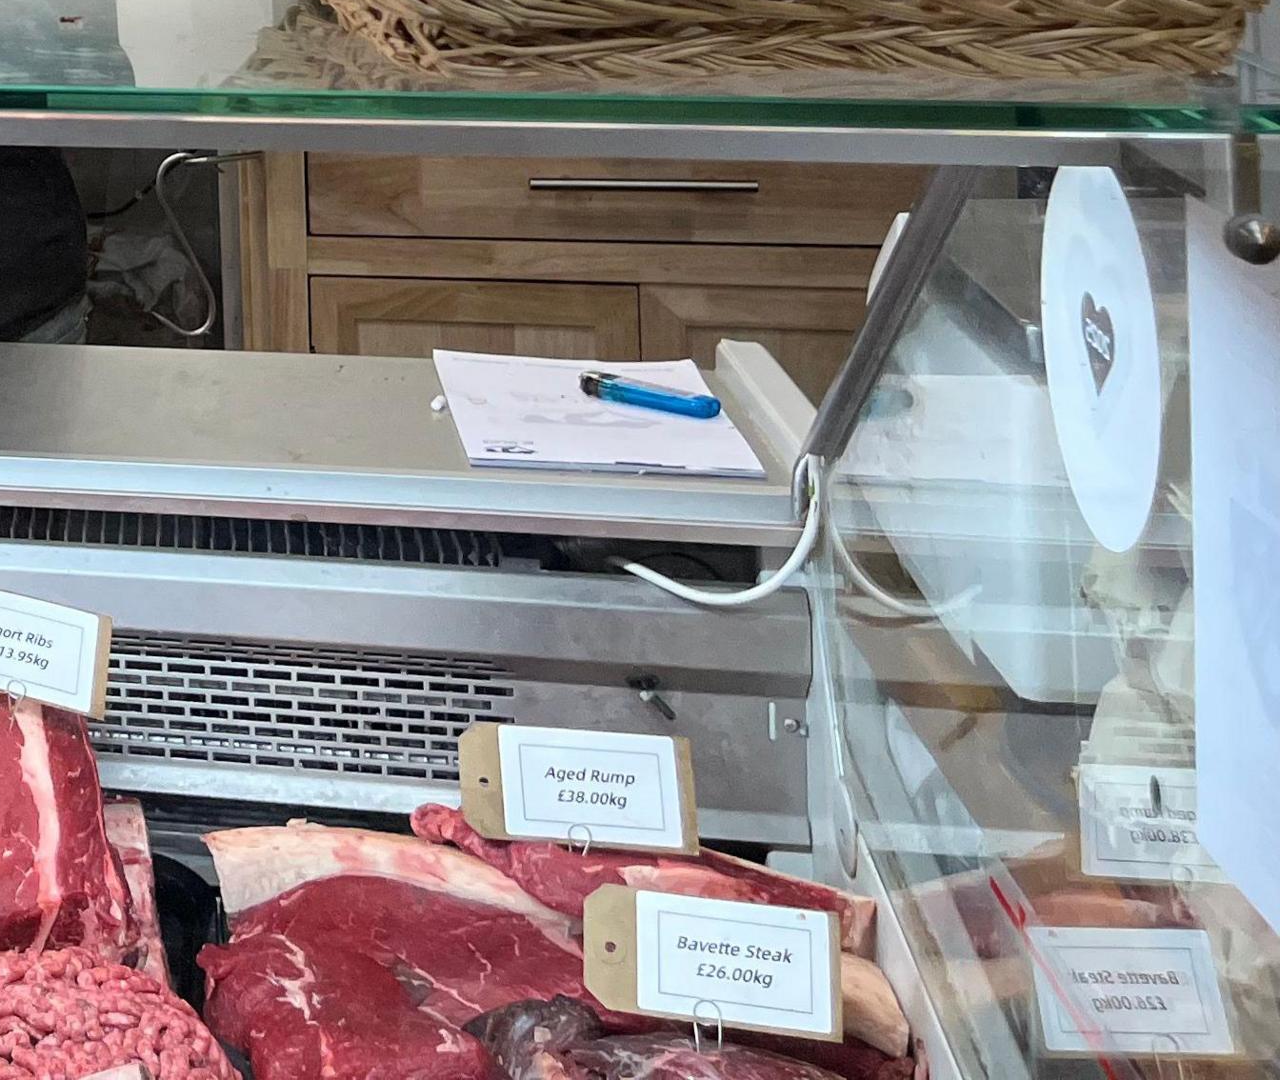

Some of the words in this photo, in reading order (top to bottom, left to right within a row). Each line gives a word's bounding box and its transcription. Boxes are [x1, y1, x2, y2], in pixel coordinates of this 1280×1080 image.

[25, 633, 54, 649] Ribs
[544, 766, 587, 783] Aged
[590, 769, 636, 788] Rump
[557, 789, 627, 810] £38.00kg
[677, 936, 740, 957] Bavette
[745, 944, 793, 964] Steak
[696, 963, 773, 989] £26.00kg
